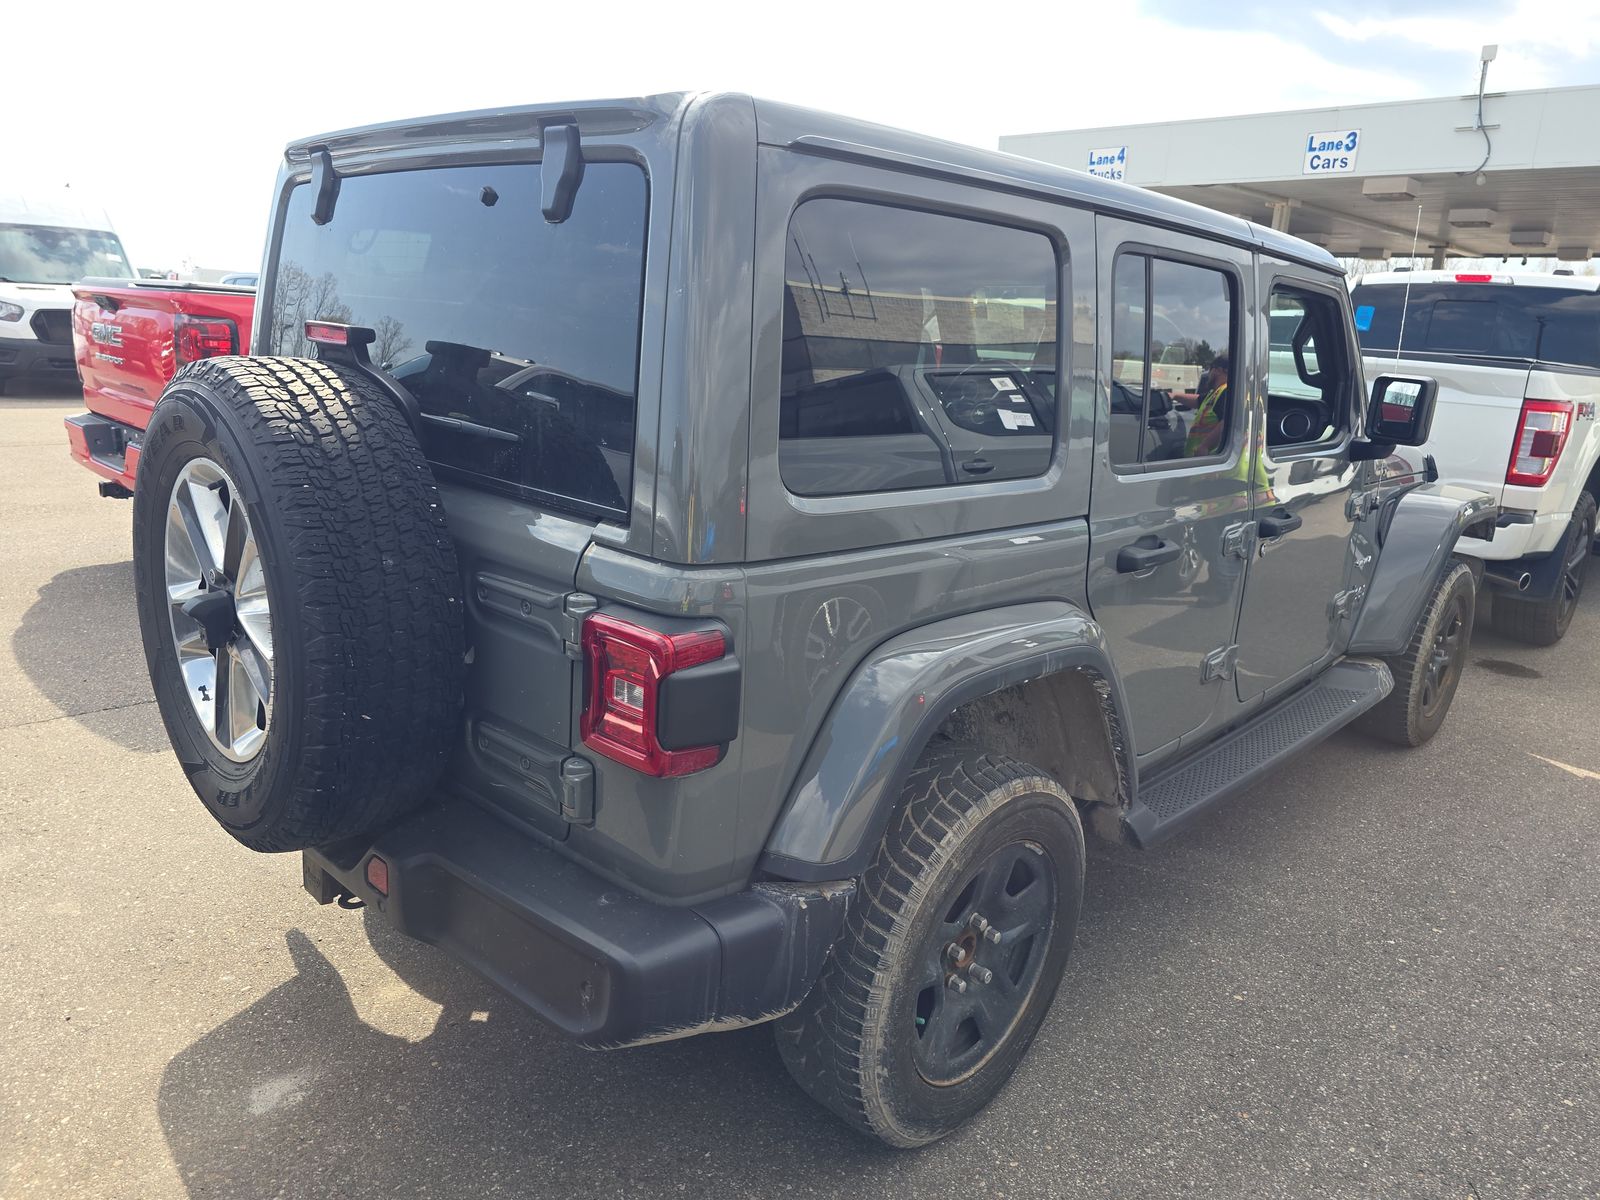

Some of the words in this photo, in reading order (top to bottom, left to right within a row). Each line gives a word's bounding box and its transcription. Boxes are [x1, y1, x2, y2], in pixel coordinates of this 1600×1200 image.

[1308, 135, 1343, 152] Lane
[1345, 131, 1358, 151] 3
[1089, 151, 1115, 165] Lane
[1117, 147, 1126, 165] 4
[1310, 154, 1348, 170] Cars
